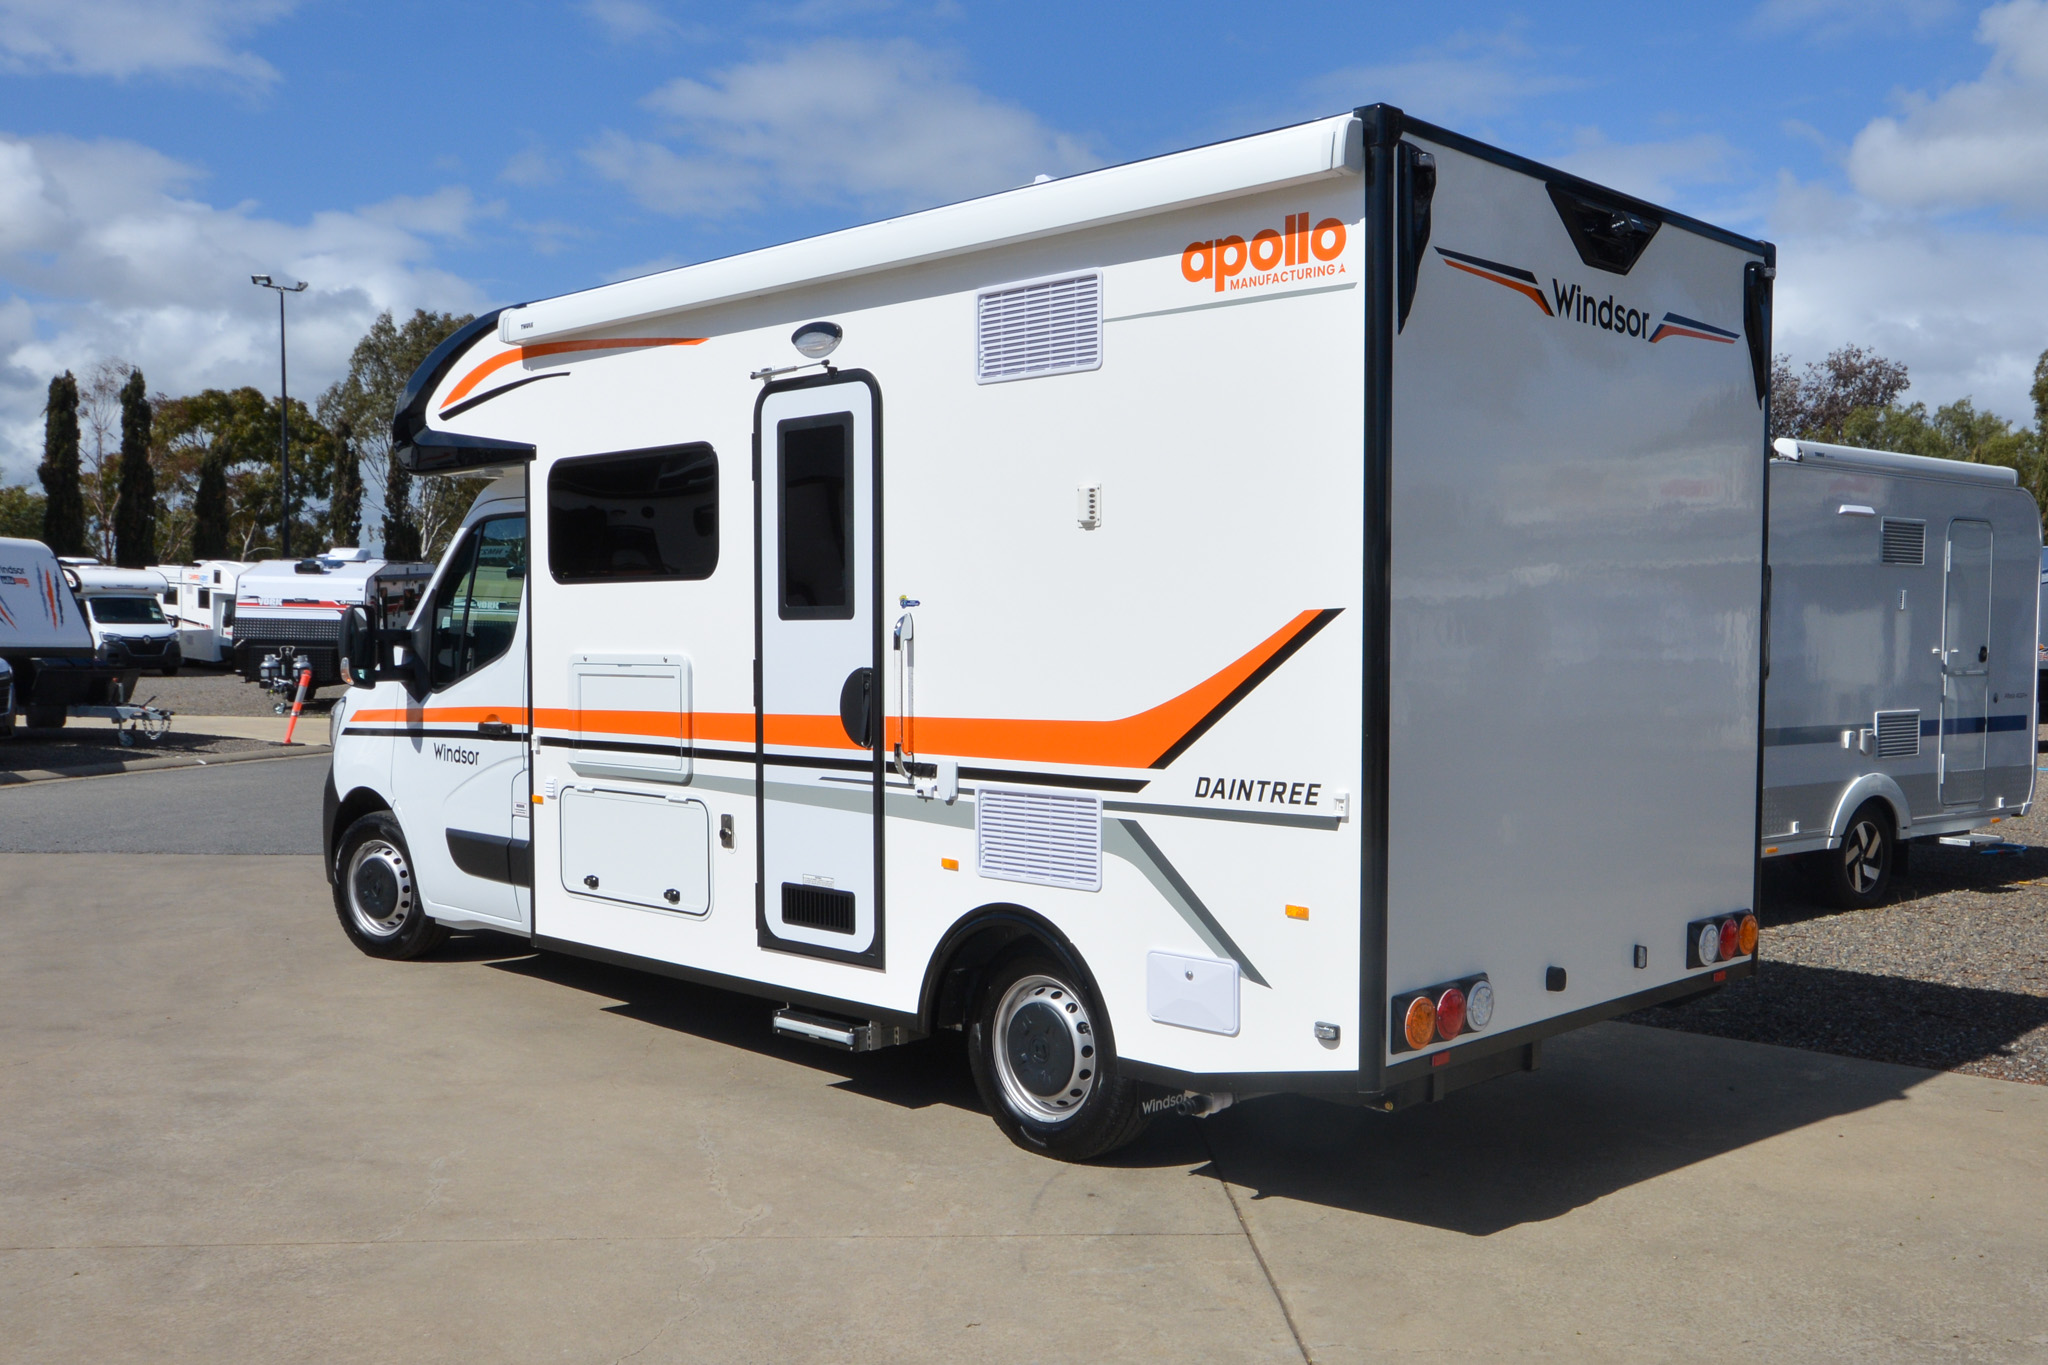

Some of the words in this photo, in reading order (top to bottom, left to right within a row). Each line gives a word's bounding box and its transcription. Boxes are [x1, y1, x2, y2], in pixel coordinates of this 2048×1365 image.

[1181, 211, 1347, 293] apollo
[1230, 264, 1336, 291] MANUFACTURING
[1552, 278, 1650, 339] Windsor
[433, 742, 480, 766] Windsor
[1195, 776, 1322, 806] DAINTREE
